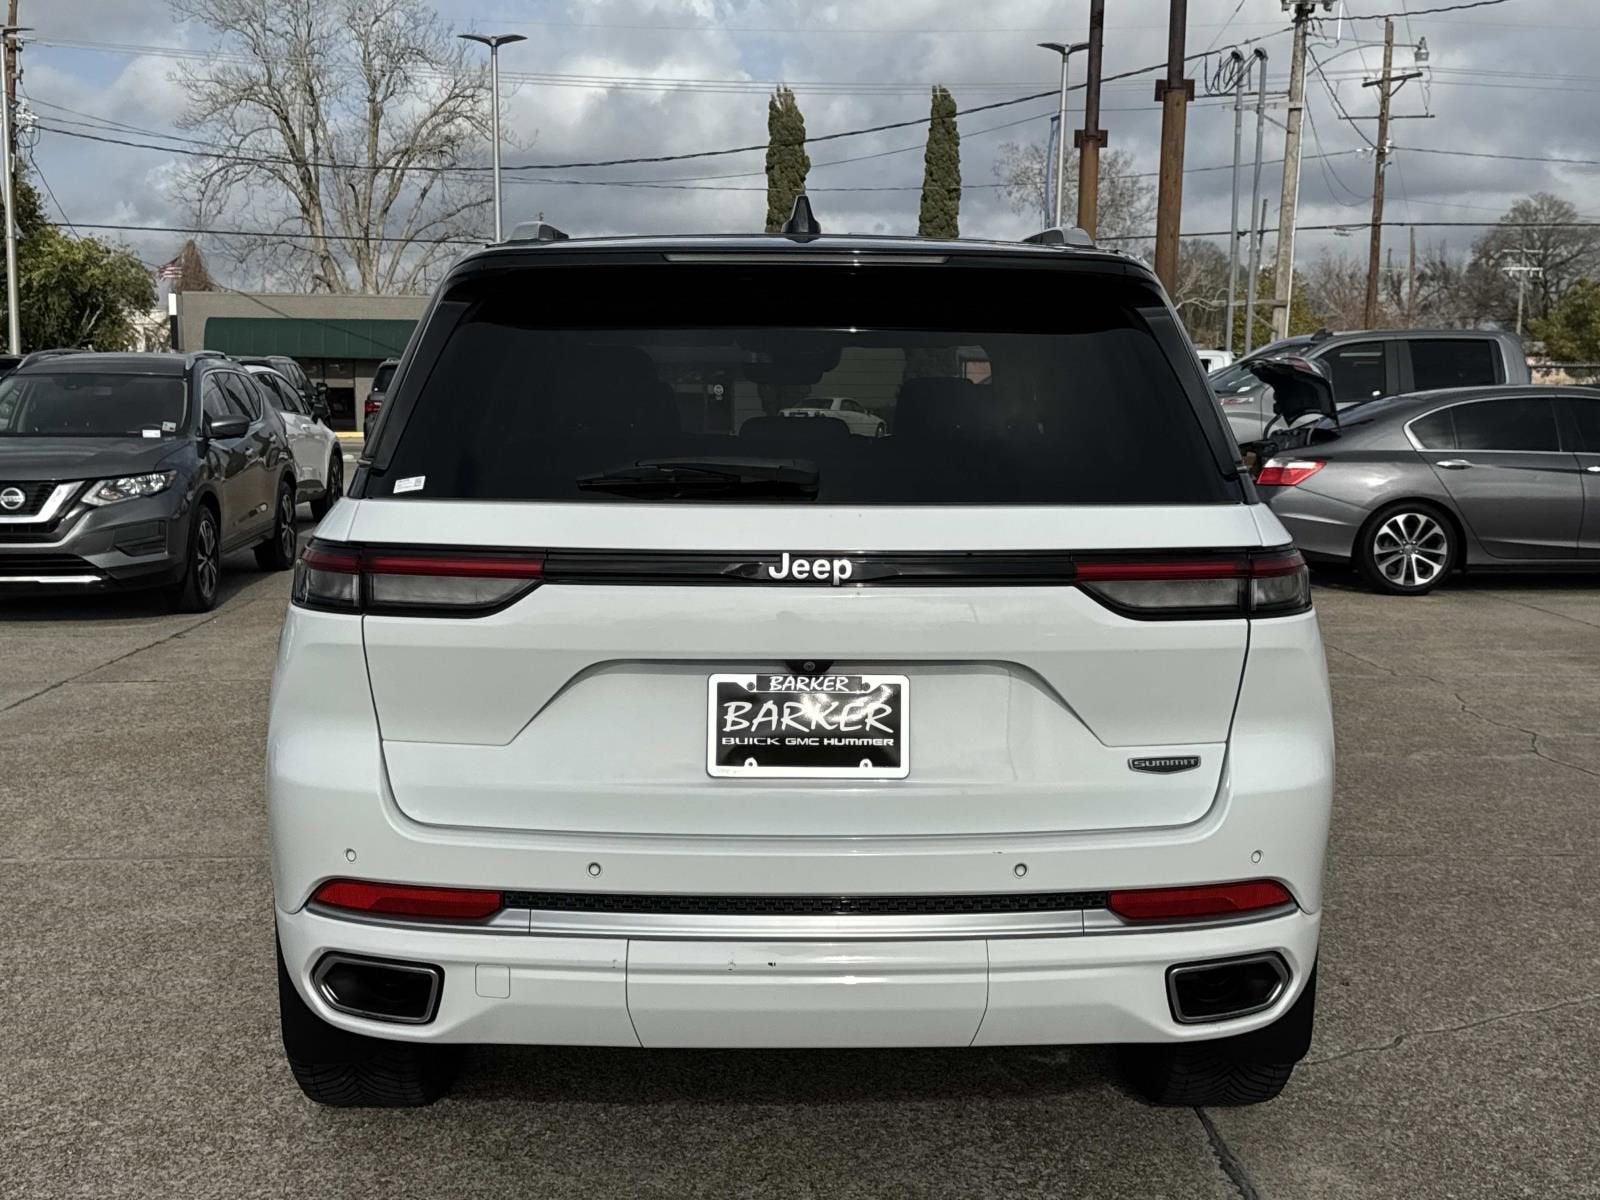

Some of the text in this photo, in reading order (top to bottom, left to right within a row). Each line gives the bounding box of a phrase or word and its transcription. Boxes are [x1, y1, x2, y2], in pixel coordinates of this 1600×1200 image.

[768, 552, 852, 585] Jeep
[769, 675, 849, 691] BARKER
[722, 700, 894, 733] BARKER
[722, 737, 894, 746] BUICK GMC HUMMER
[1134, 759, 1196, 767] SUMMIT
